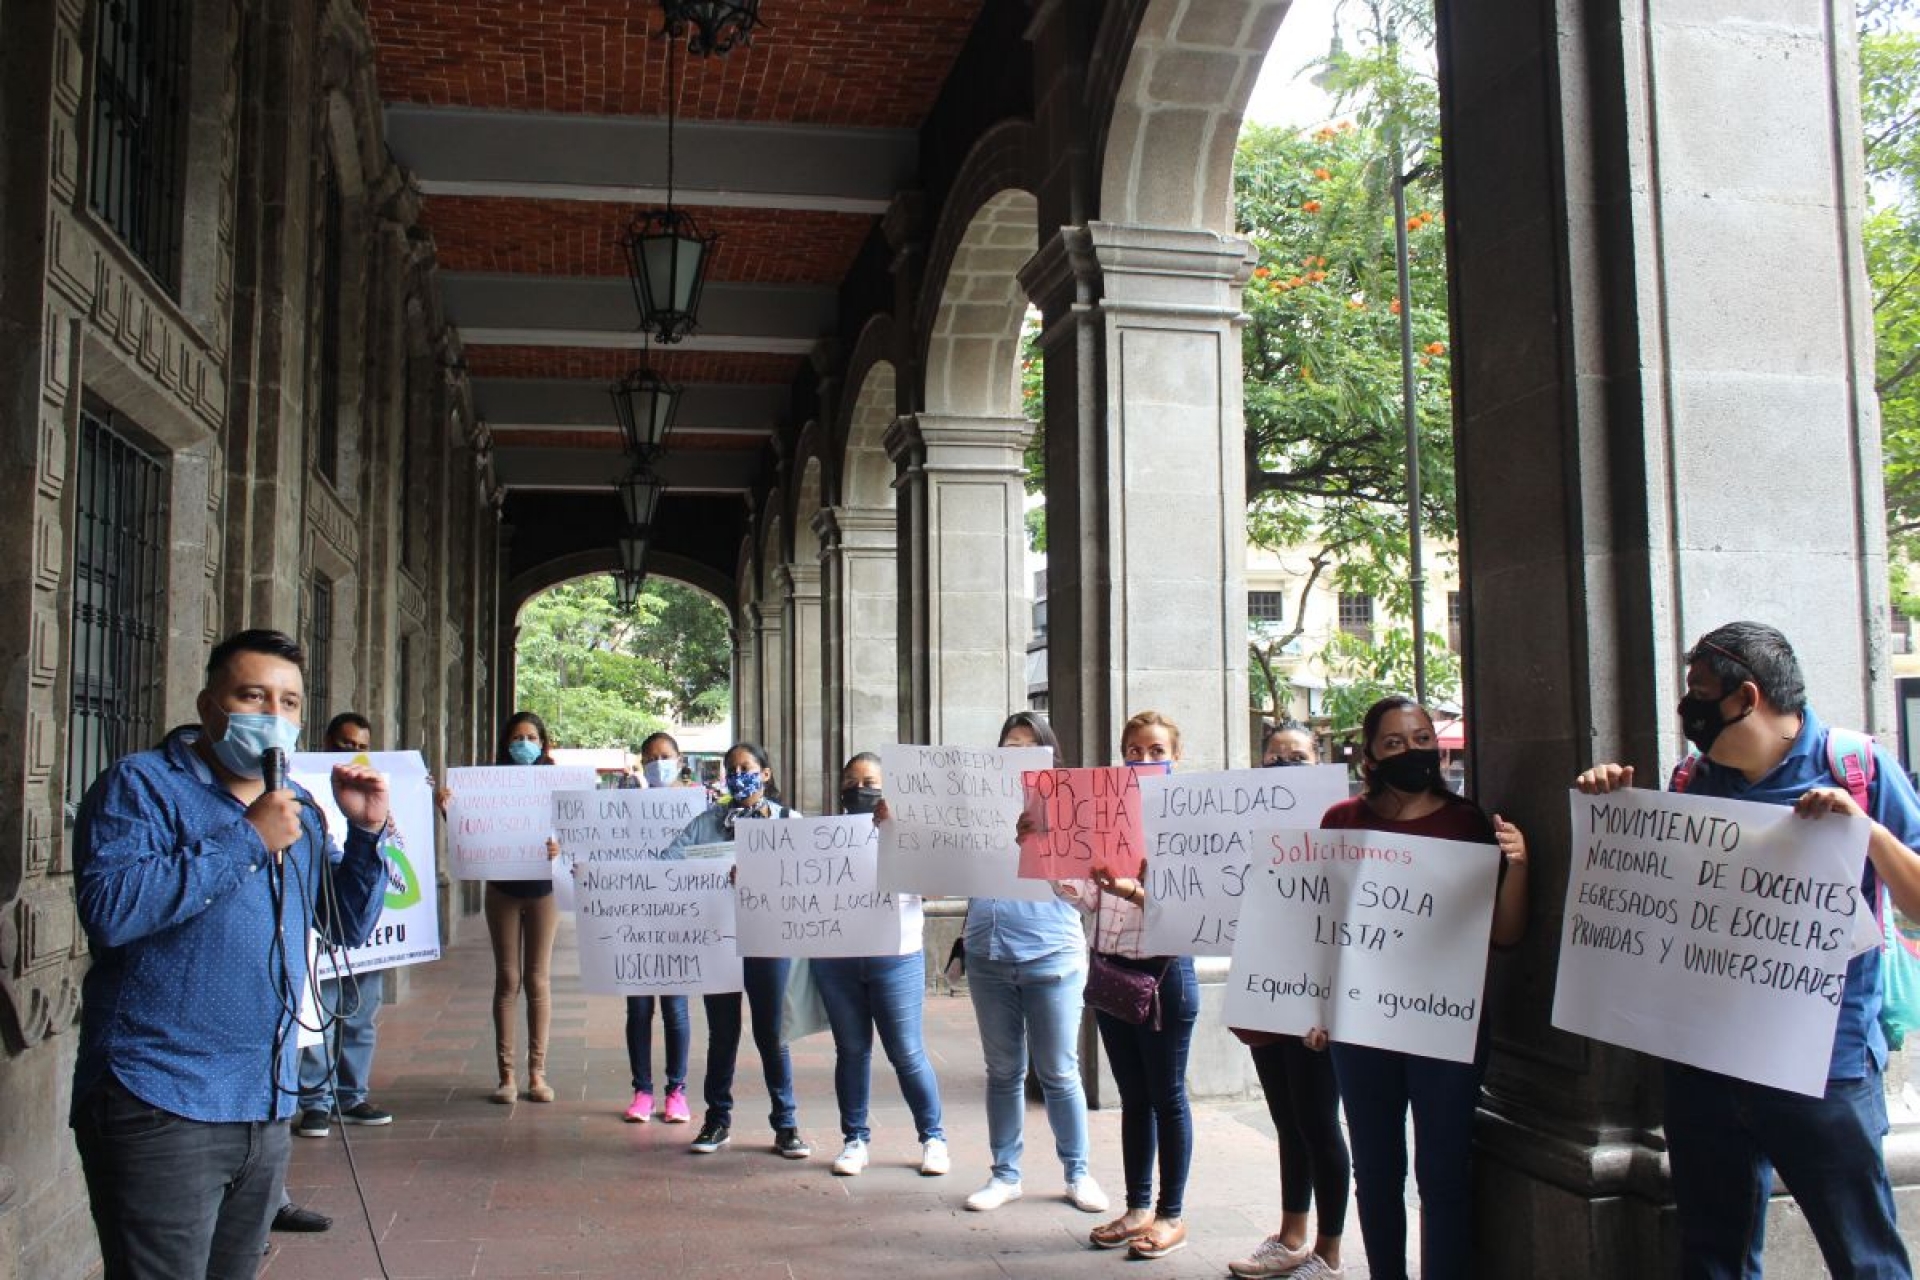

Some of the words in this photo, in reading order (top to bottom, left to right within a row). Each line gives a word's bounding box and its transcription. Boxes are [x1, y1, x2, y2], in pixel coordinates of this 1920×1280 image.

[896, 772, 935, 797] UNA
[946, 771, 994, 797] SOLA
[1023, 769, 1076, 801] POR
[1092, 768, 1140, 798] UNA
[557, 801, 585, 821] POR
[599, 801, 631, 821] UNA
[642, 801, 693, 821] LUCHA
[1041, 799, 1132, 832] LUCHA
[1159, 785, 1297, 818] IGUALDAD
[557, 826, 600, 846] JUSTA
[612, 828, 631, 840] EN
[640, 827, 654, 841] EL
[747, 827, 794, 852] UNA
[813, 825, 879, 851] SOLA
[898, 832, 920, 851] ES
[931, 831, 1009, 851] PRIMERO
[1590, 803, 1741, 852] MOVIMIENTO
[1039, 830, 1132, 859] JUSTA
[1154, 829, 1253, 857] EQUIDA
[1271, 831, 1413, 865] Solicitamos
[588, 869, 658, 891] NORMAL
[780, 857, 857, 886] LISTA
[1152, 866, 1205, 902] UNA
[1586, 840, 1673, 880] NACIONAL
[1697, 860, 1729, 890] DE
[1740, 866, 1857, 917] DOCENTES
[740, 890, 771, 912] POR
[781, 893, 822, 913] UNA
[833, 891, 895, 912] LUCHA
[1357, 880, 1434, 918] SOLA
[781, 920, 843, 940] JUSTA
[1578, 883, 1679, 925] EGRESADOS
[1690, 901, 1721, 933] DE
[1730, 906, 1845, 952] ESCUELAS
[615, 953, 702, 980] USICAMM
[1571, 913, 1645, 956] PRIVADAS
[1658, 937, 1675, 964] Y
[1684, 942, 1847, 1007] UNIVERSIDADES
[1246, 973, 1332, 1003] Equidad
[1348, 987, 1361, 1001] e
[1377, 992, 1476, 1022] igualdad
